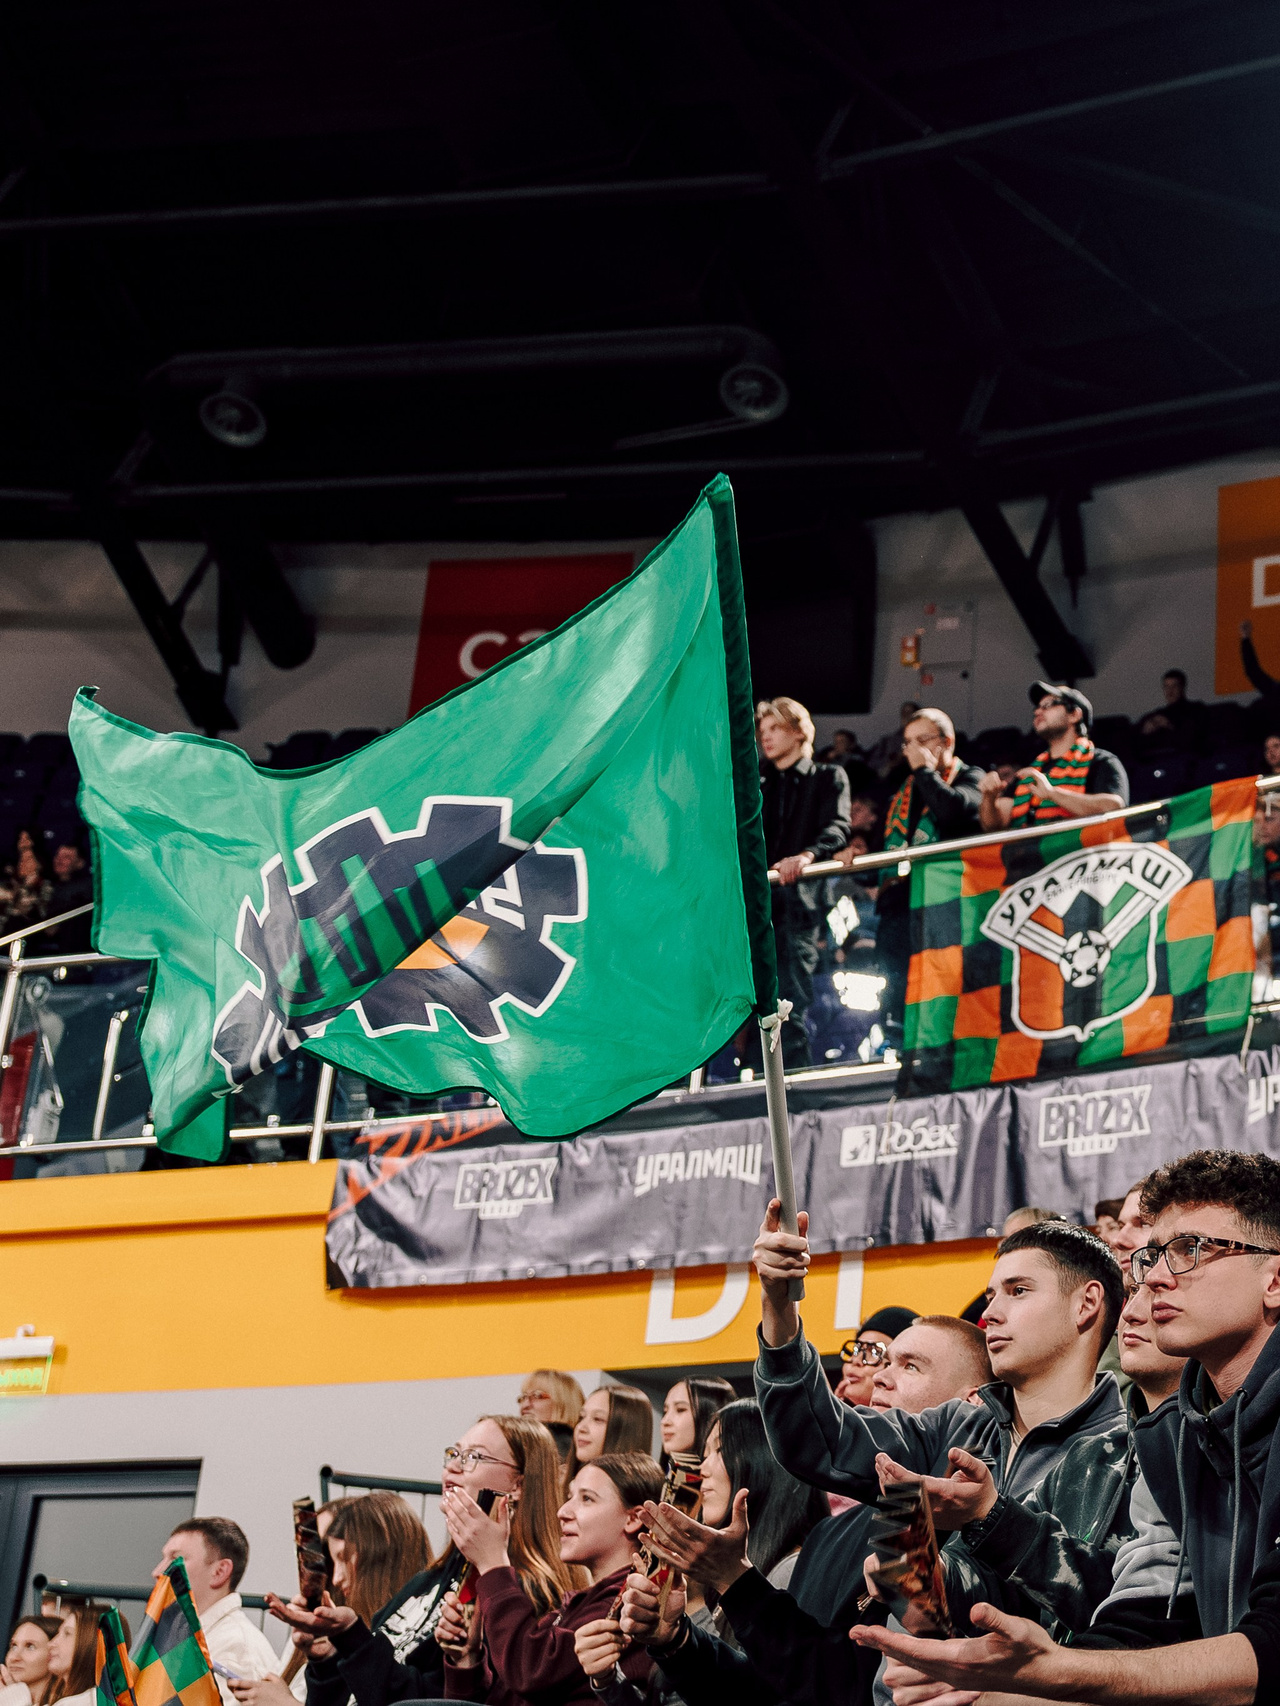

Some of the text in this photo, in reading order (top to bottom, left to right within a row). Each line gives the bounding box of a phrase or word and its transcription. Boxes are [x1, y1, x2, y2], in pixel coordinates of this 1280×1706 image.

[1000, 855, 1172, 928] УРАЛМАШ
[1041, 1086, 1150, 1146] BROZEX
[633, 1142, 763, 1198] УРАЛМАШ
